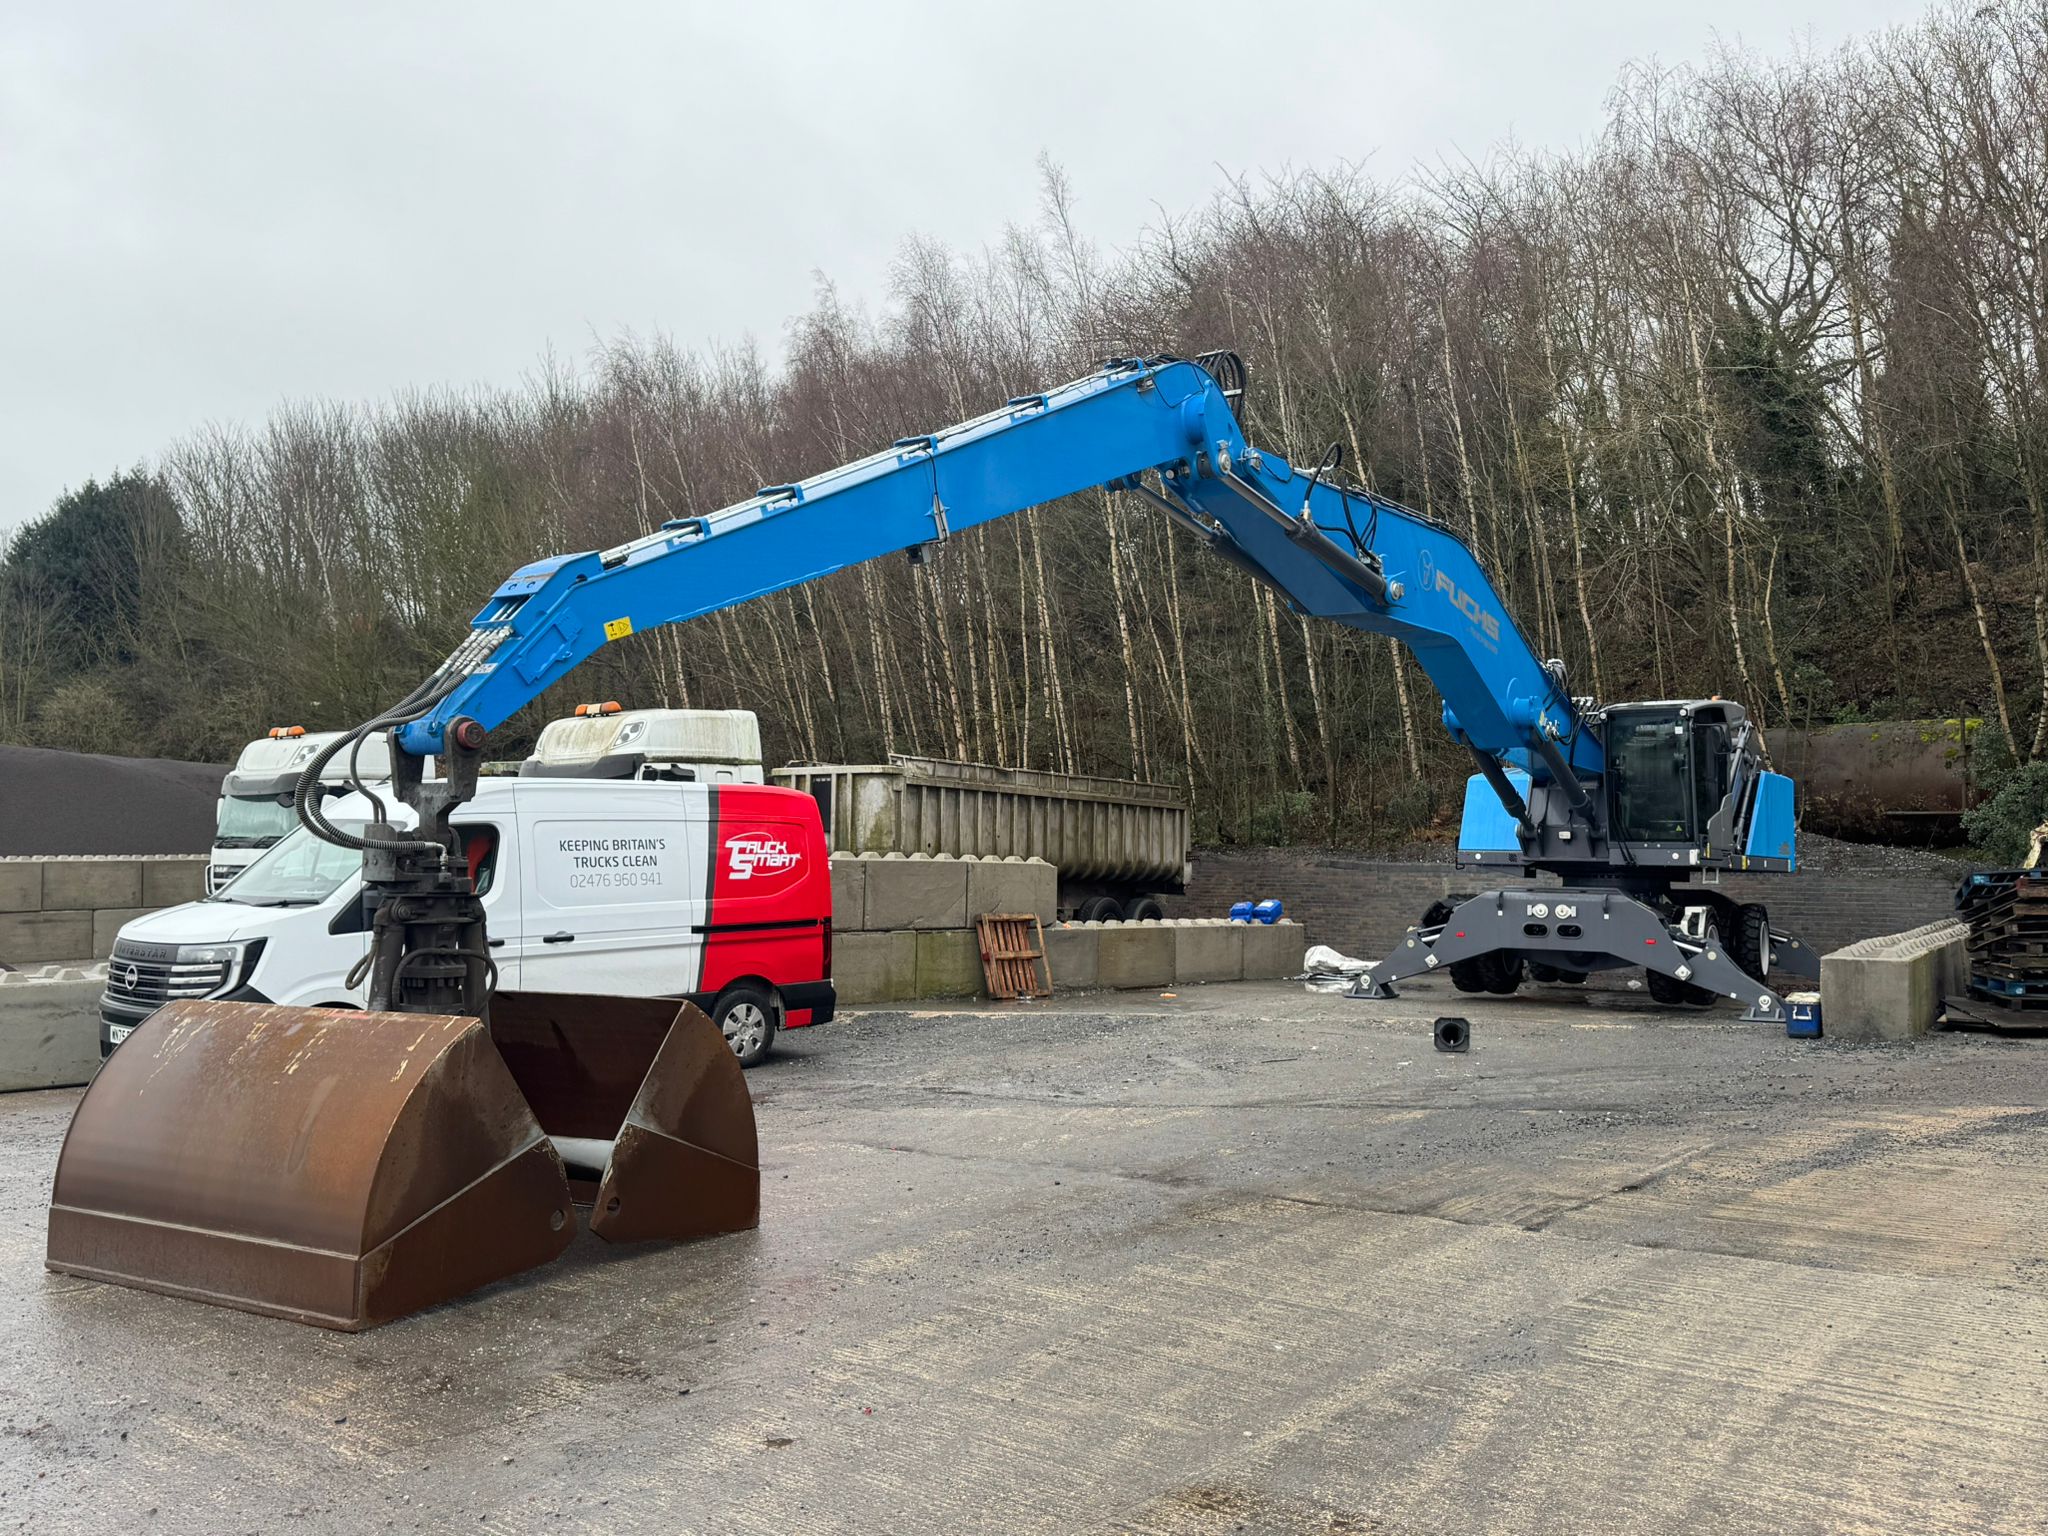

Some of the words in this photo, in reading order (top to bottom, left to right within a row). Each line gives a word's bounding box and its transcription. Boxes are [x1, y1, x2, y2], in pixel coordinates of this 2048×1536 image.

[1436, 569, 1500, 641] FUCHS
[559, 839, 609, 852] KEEPING
[612, 838, 666, 851] BRITAIN'S
[573, 856, 619, 869] TRUCKS
[622, 855, 658, 867] CLEAN
[725, 841, 787, 867] TRUCK
[570, 873, 611, 888] 02476
[614, 872, 638, 887] 960
[640, 871, 663, 886] 941
